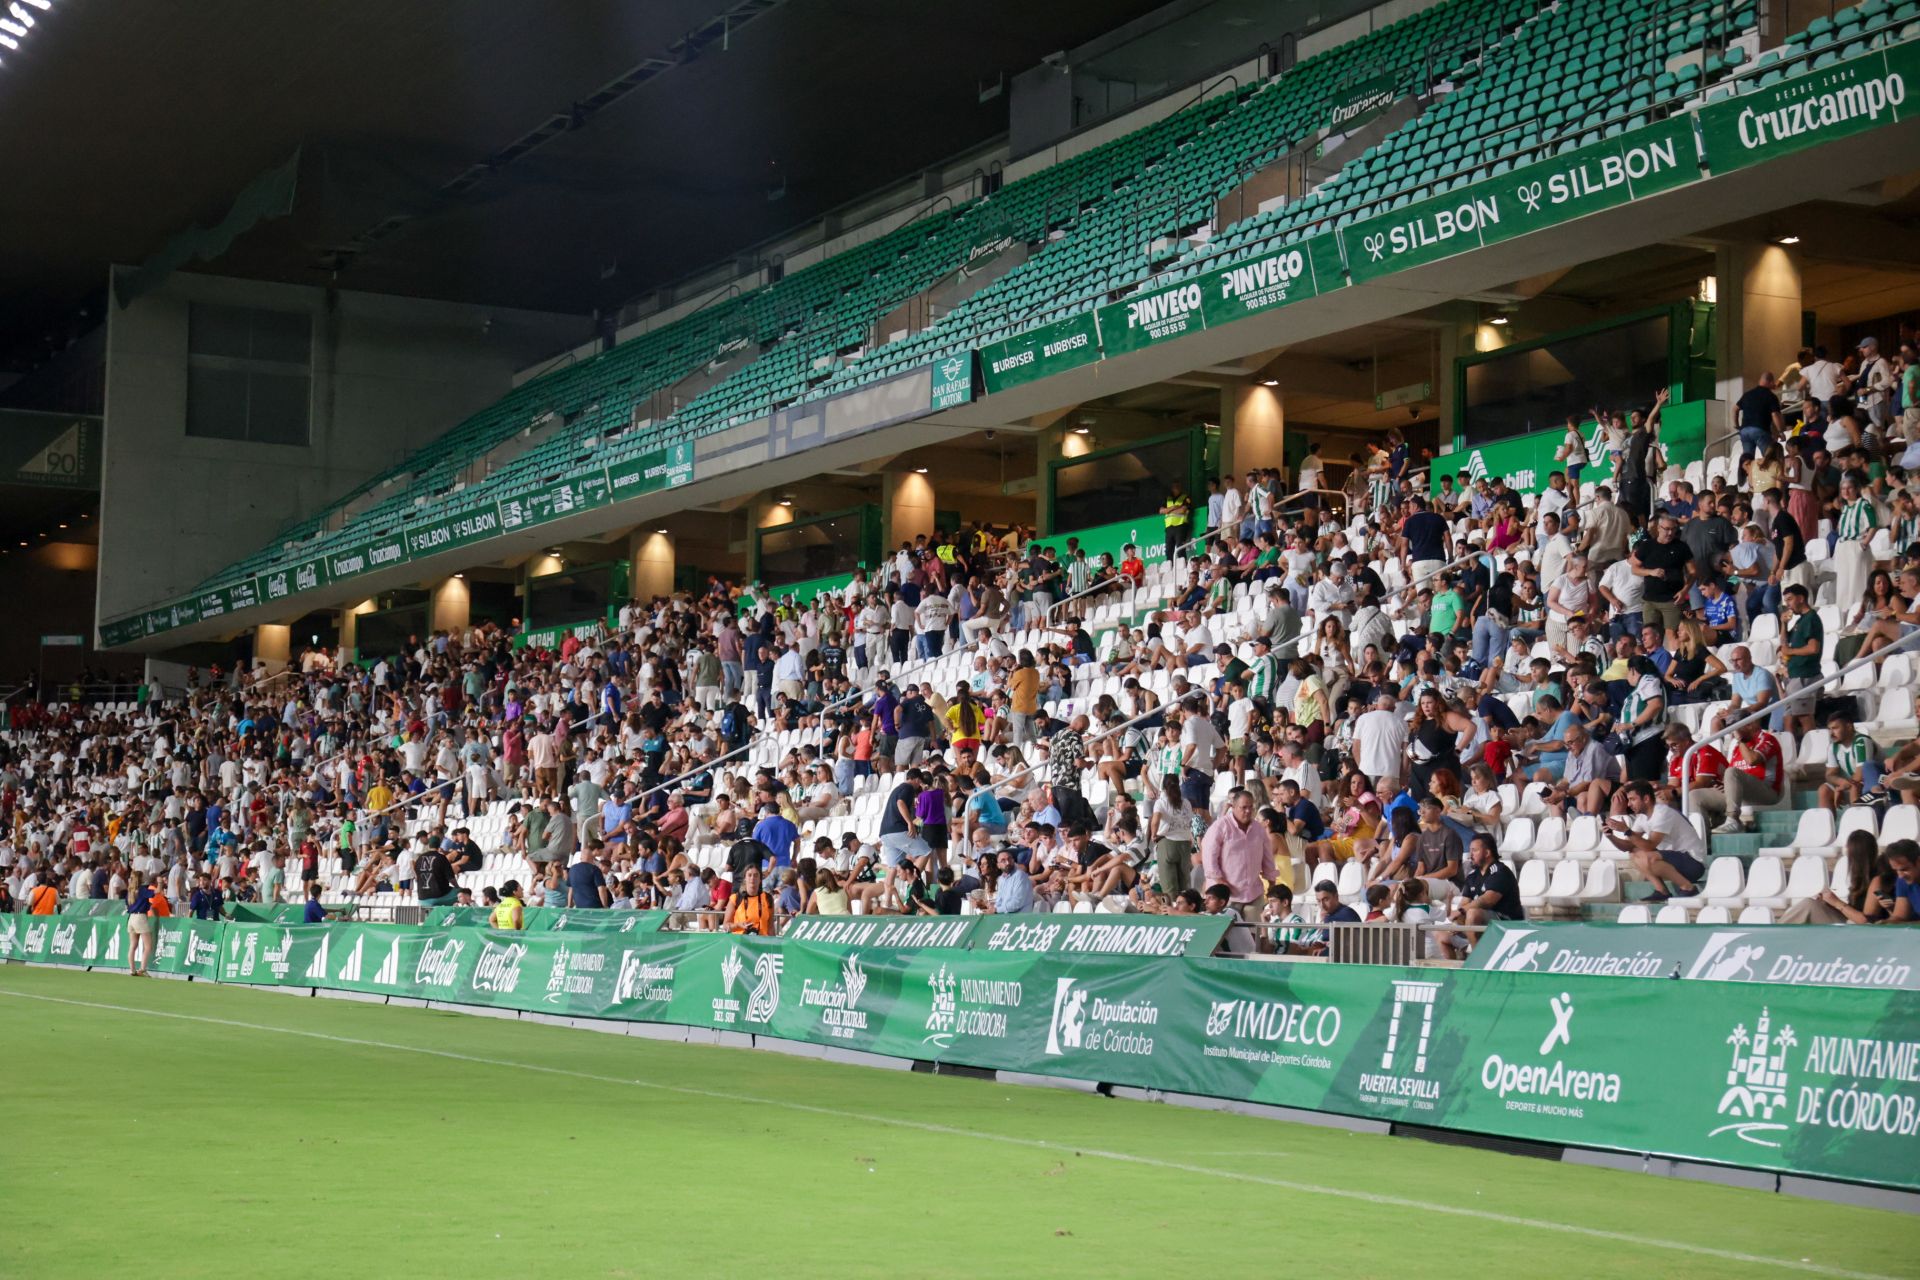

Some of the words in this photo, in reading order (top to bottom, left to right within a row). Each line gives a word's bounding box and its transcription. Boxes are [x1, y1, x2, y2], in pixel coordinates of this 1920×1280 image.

[1775, 82, 1813, 102] DESDE
[1738, 73, 1905, 150] Cruzcampo
[1548, 137, 1677, 205] SILBON
[1389, 195, 1500, 254] SILBON
[1221, 250, 1303, 299] PINVECO
[1127, 283, 1202, 329] PINVECO
[1245, 298, 1259, 311] 900
[1050, 333, 1088, 355] URBYSER
[1150, 328, 1162, 340] 900
[999, 350, 1034, 372] URBYSER
[933, 384, 946, 398] SAN
[940, 391, 962, 408] MOTOR
[47, 452, 76, 474] 90
[418, 526, 450, 549] SILBON
[460, 512, 496, 536] SILBON
[873, 921, 969, 948] BAHRAIN
[1061, 925, 1180, 955] PATRIMONIO
[1180, 928, 1197, 942] DE
[638, 963, 674, 981] Diputación
[1548, 949, 1663, 976] Diputación
[1766, 954, 1911, 986] Diputación
[633, 986, 644, 1000] de
[643, 985, 673, 1002] Córdoba
[799, 978, 847, 1012] Fundación
[960, 978, 1022, 1008] AYUNTAMIENTO
[823, 1009, 843, 1025] CAJA
[842, 1010, 868, 1030] RURAL
[956, 1011, 967, 1034] DE
[967, 1006, 1008, 1038] CÓRDOBA
[1092, 998, 1158, 1025] Diputación
[1234, 999, 1341, 1047] IMDECO
[1085, 1028, 1101, 1050] de
[1103, 1029, 1153, 1056] Córdoba
[1203, 1044, 1228, 1058] Instituto
[1228, 1046, 1261, 1064] Municipal
[1261, 1050, 1271, 1063] de
[1271, 1051, 1301, 1067] Deportes
[1301, 1054, 1332, 1069] Córdoba
[1359, 1073, 1398, 1094] PUERTA
[1398, 1077, 1440, 1100] SEVILLA
[1481, 1053, 1621, 1104] OpenArena
[1505, 1100, 1536, 1113] DEPORTE
[1542, 1104, 1568, 1117] MUCHO
[1568, 1106, 1584, 1119] MÁS
[1796, 1086, 1822, 1126] DE
